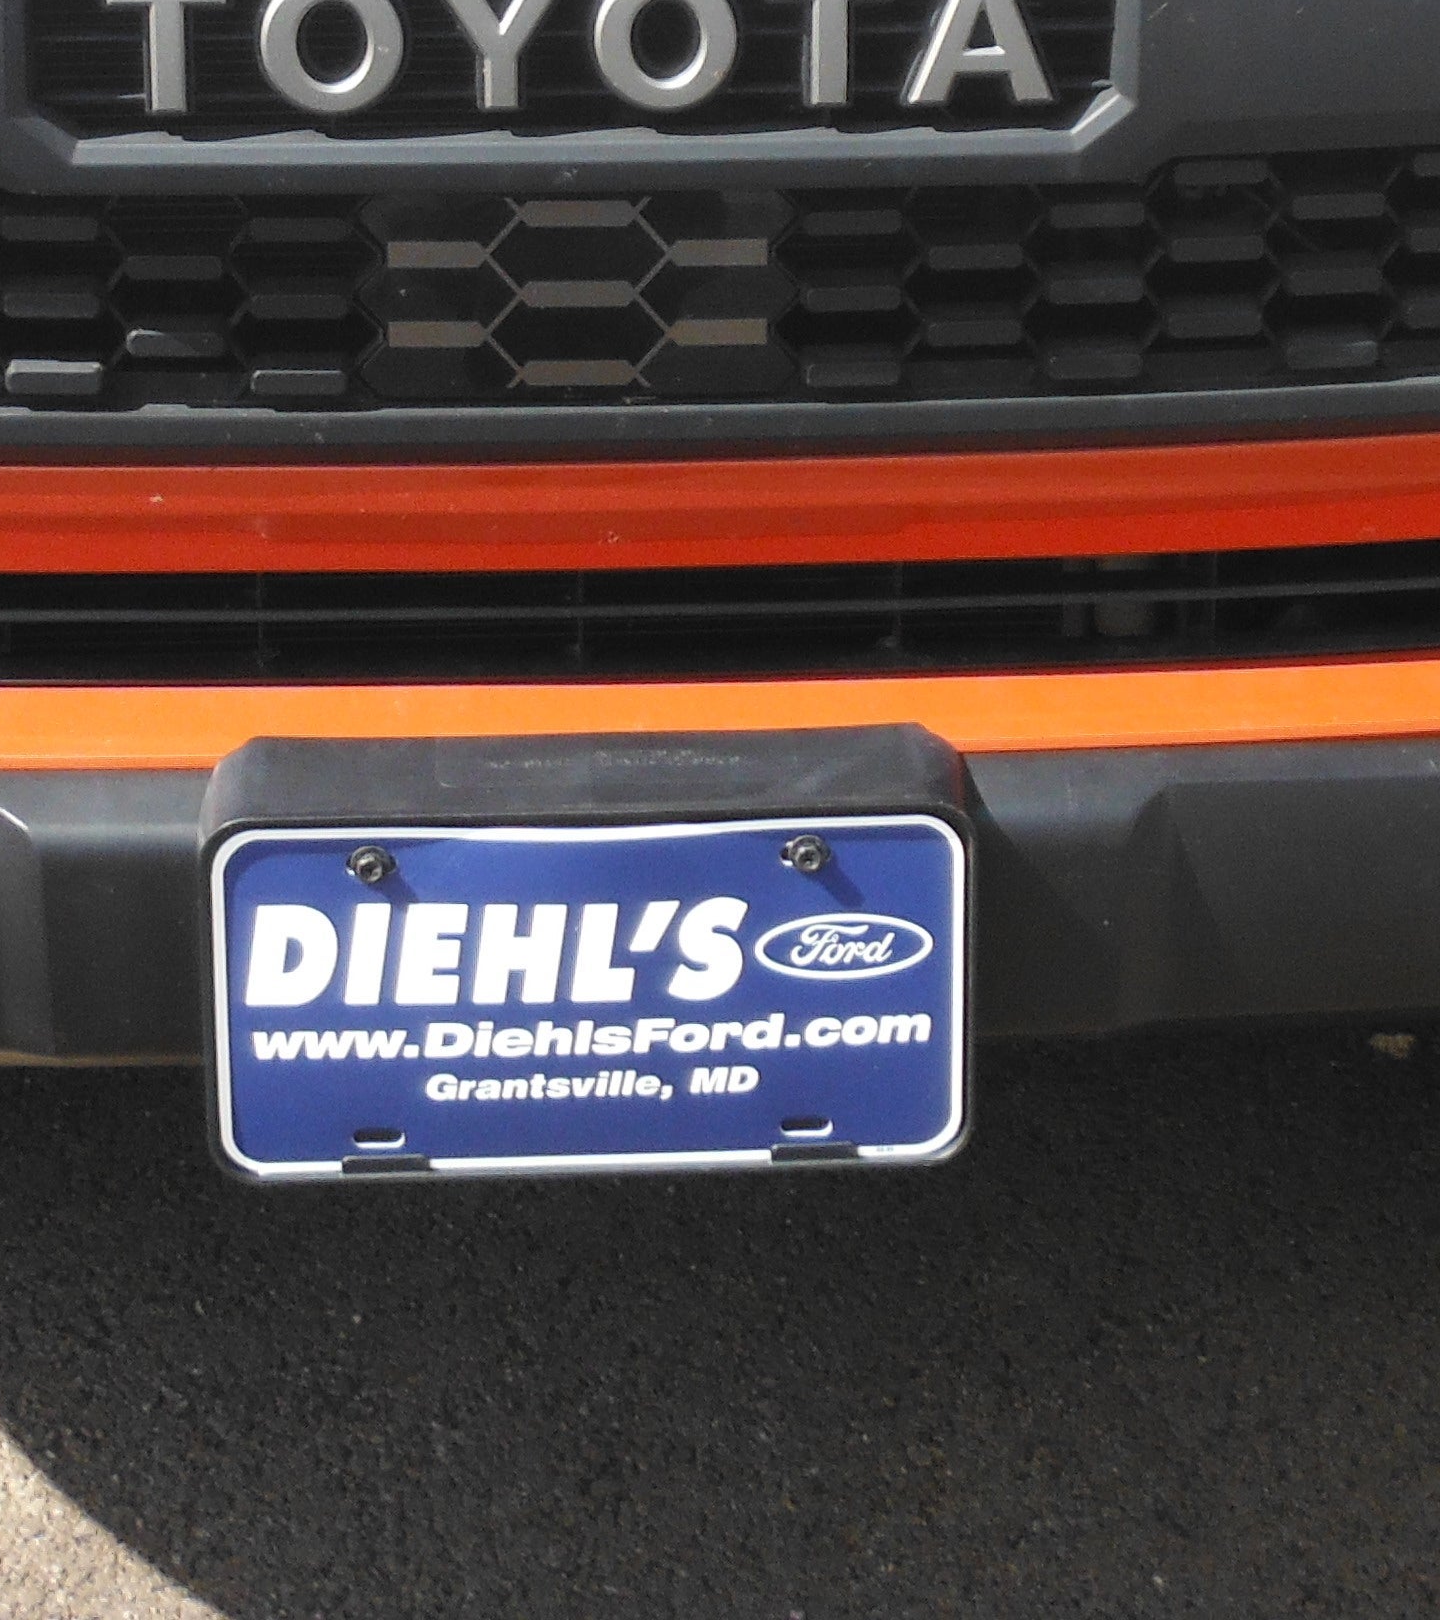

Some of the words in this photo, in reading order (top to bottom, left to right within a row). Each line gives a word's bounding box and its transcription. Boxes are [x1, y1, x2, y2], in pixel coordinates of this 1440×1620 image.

[245, 897, 748, 1005] DIEHL'S
[790, 924, 895, 966] Ford
[253, 1013, 932, 1059] www.DiehlsFord.com
[426, 1070, 673, 1100] Grantsville,
[690, 1066, 761, 1094] MD
